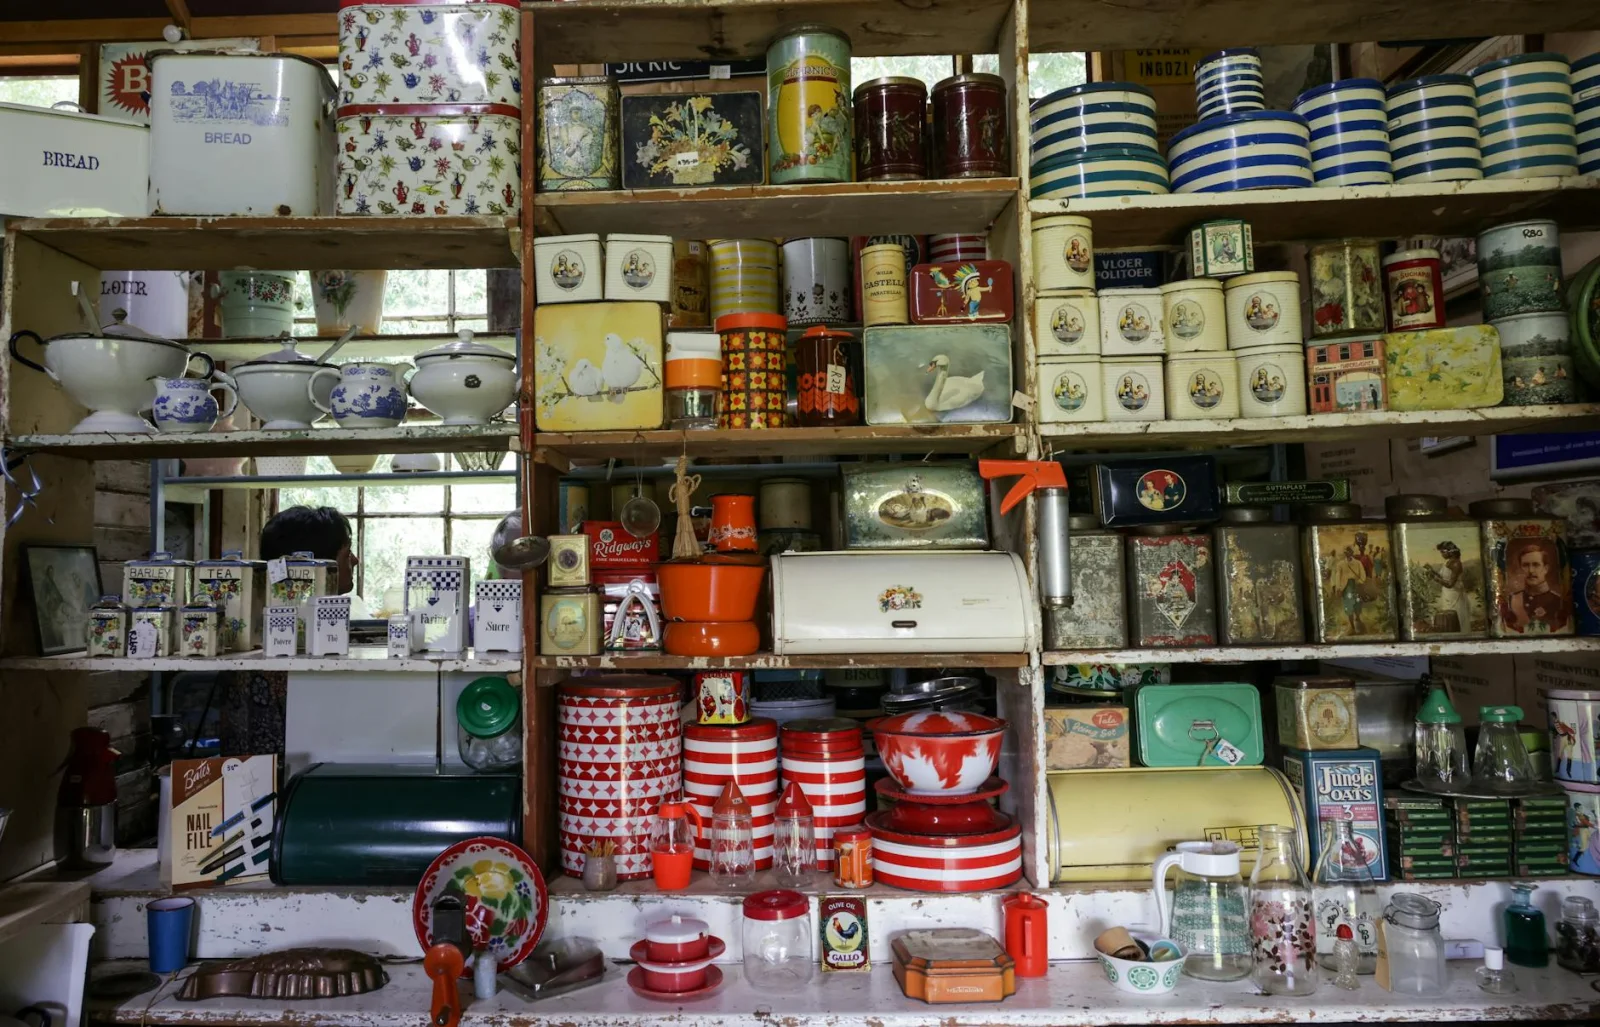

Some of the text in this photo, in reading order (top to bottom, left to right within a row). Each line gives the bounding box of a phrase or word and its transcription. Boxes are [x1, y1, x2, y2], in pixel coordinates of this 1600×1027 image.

[1140, 61, 1188, 76] INGOZI
[204, 132, 252, 145] BREAD
[43, 150, 100, 171] BREAD
[1102, 257, 1143, 270] VLOER
[100, 280, 148, 296] LOUR
[129, 567, 171, 579] BARLEY
[207, 568, 233, 579] TEA
[287, 568, 311, 579] OUR
[420, 613, 448, 625] Farine
[485, 621, 510, 632] Sucre
[1318, 765, 1375, 794] Jungle
[1330, 789, 1373, 801] OATS
[1342, 804, 1354, 820] 3
[186, 812, 212, 832] NAIL
[186, 831, 213, 850] FILE
[828, 901, 856, 910] OLIVE OIL
[831, 953, 860, 962] GALLO
